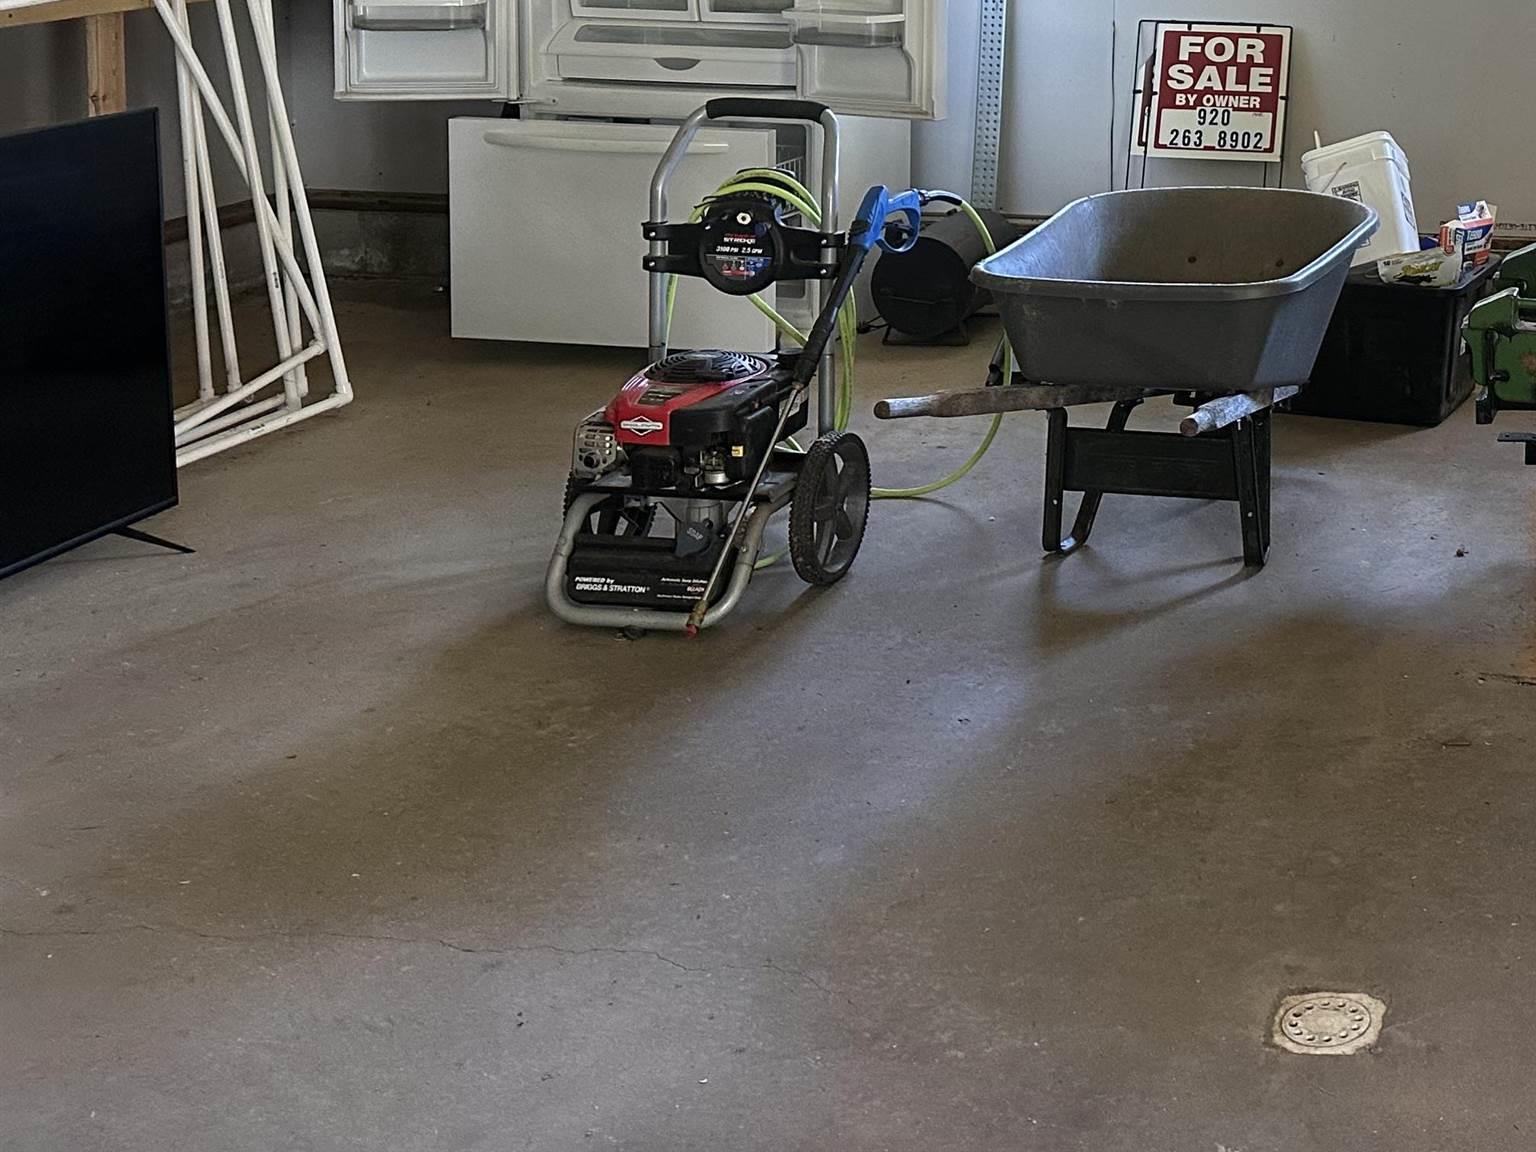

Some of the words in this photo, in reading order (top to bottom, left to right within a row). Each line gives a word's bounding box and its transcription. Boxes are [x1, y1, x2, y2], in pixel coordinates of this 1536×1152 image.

[1178, 35, 1266, 64] FOR
[1166, 63, 1273, 93] SALE
[1175, 93, 1198, 106] BY
[1202, 94, 1261, 109] OWNER
[1197, 108, 1231, 126] 920
[1168, 129, 1203, 147] 263
[1217, 130, 1263, 150] 8902
[575, 583, 603, 592] BRIGGS
[608, 584, 647, 593] STRATTON
